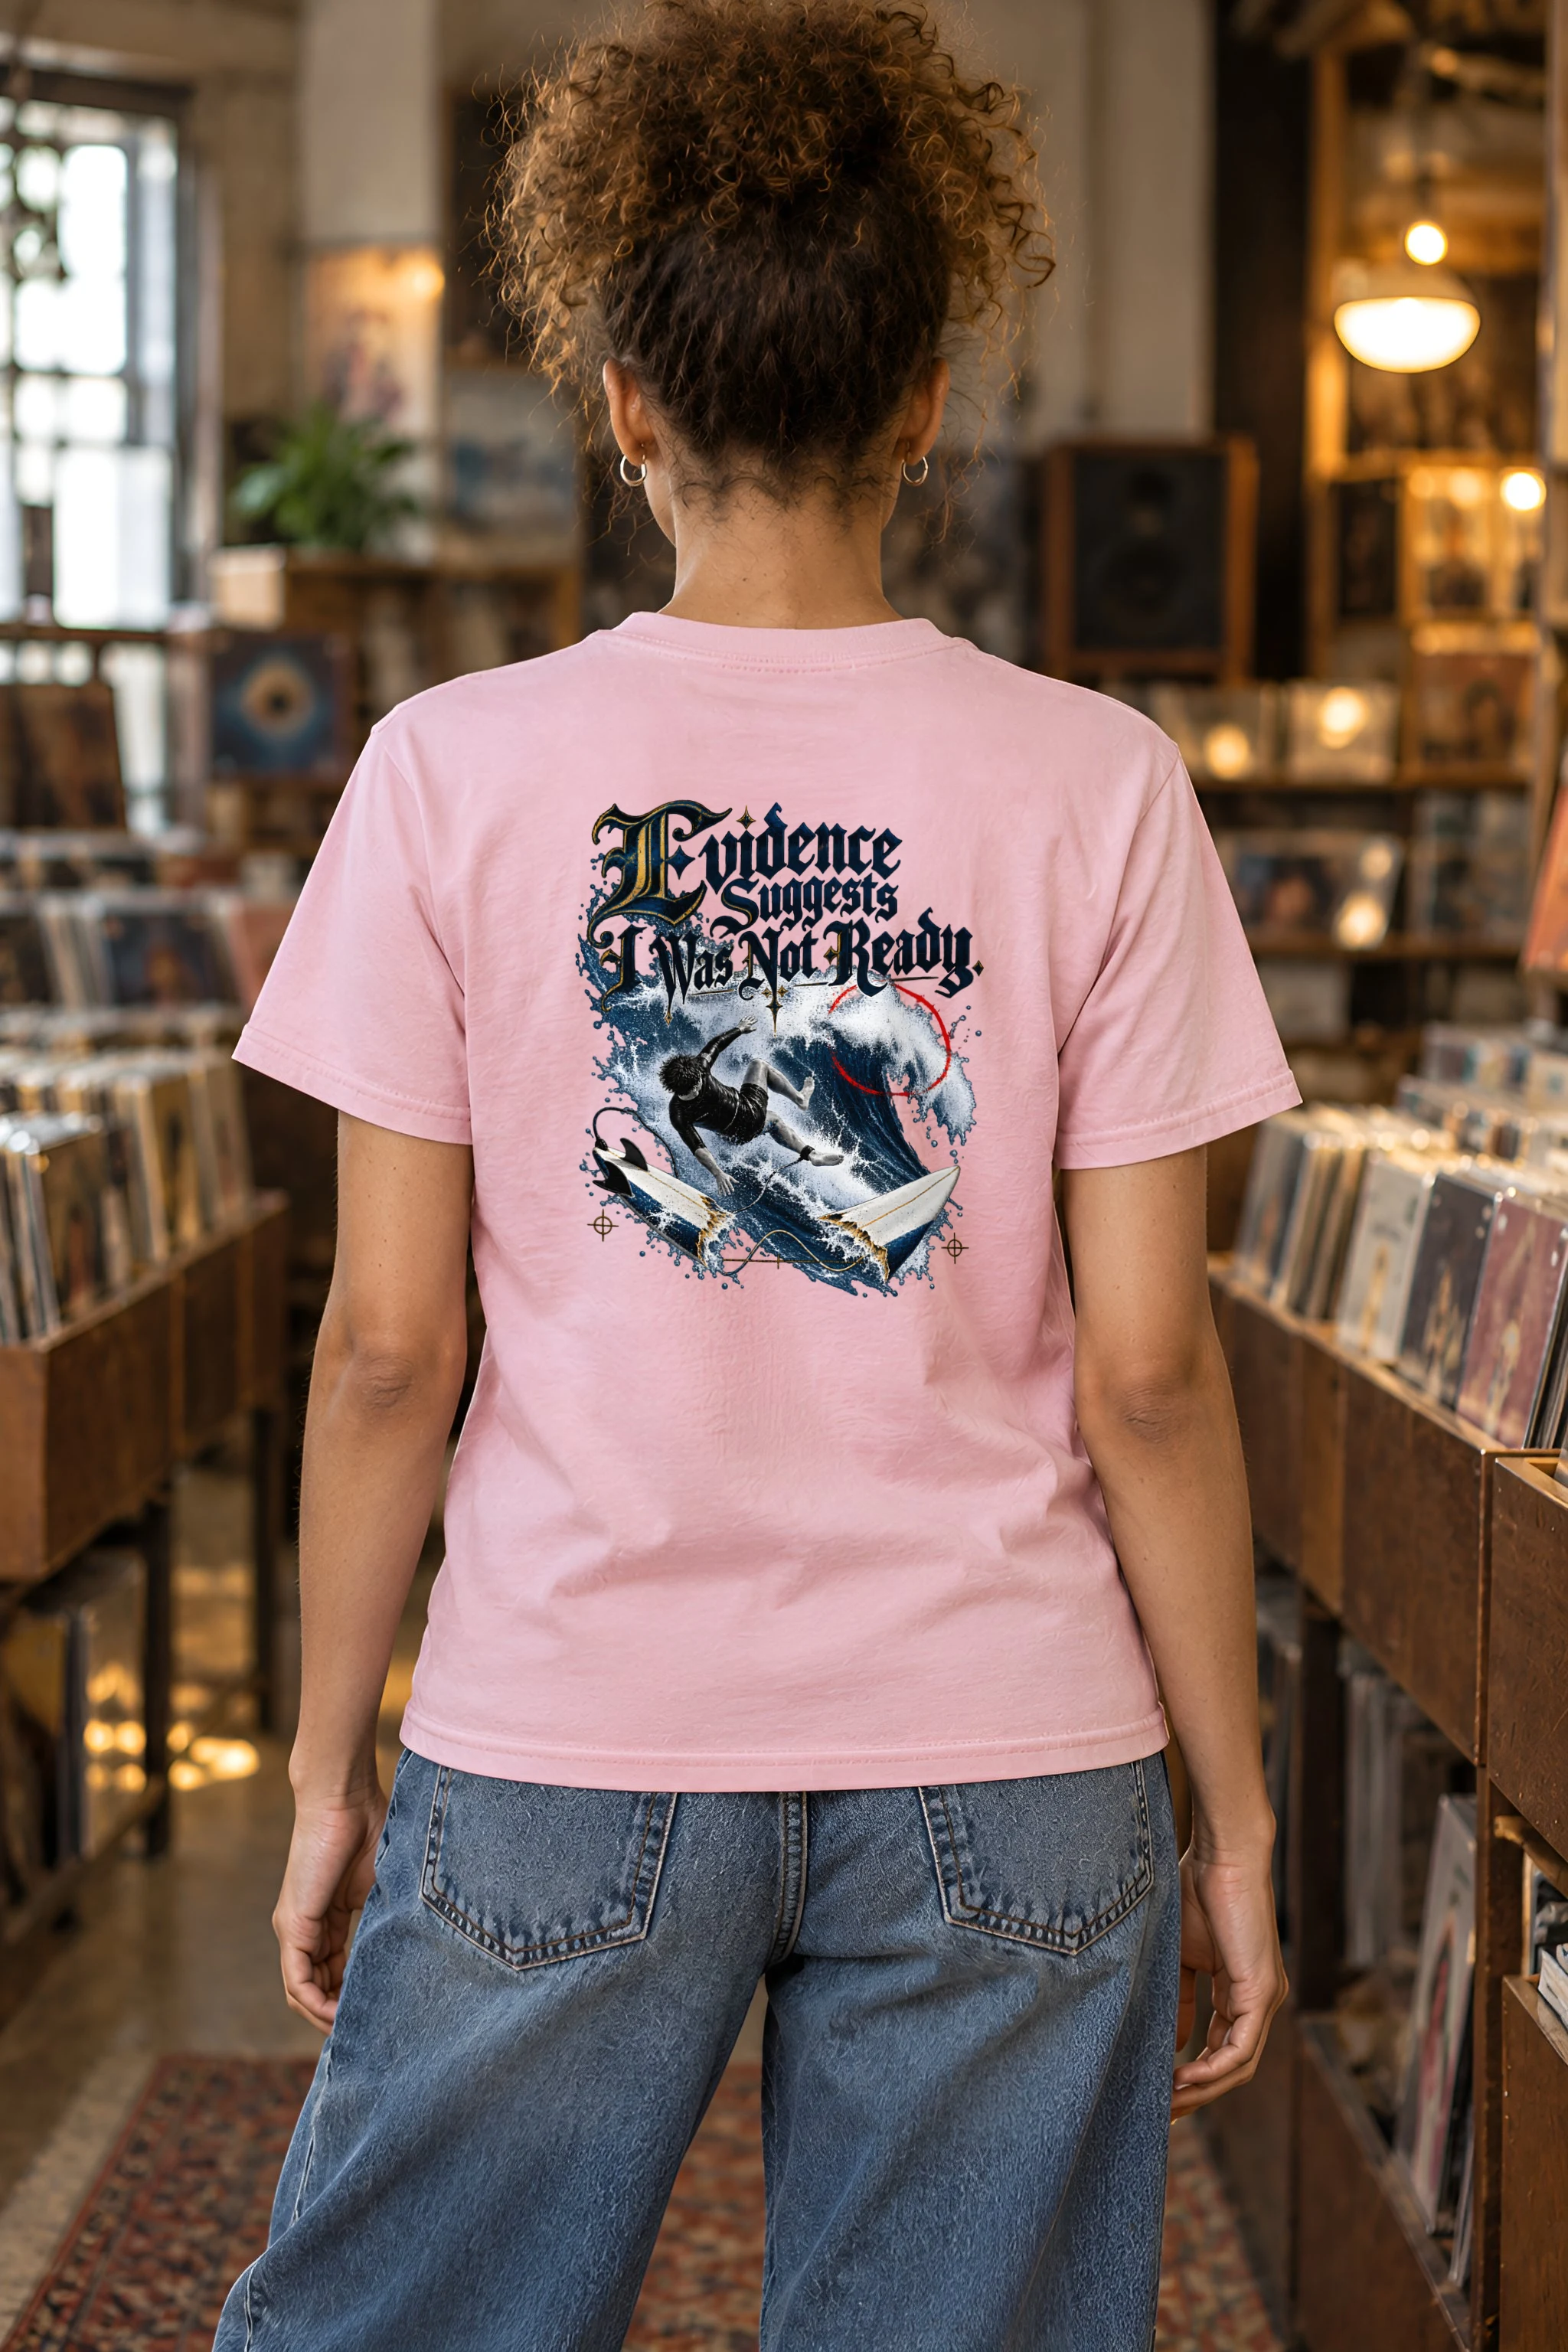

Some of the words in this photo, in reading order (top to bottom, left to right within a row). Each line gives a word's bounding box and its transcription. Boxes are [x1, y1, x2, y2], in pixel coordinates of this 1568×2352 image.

[590, 799, 903, 948] Evidence
[710, 872, 899, 938] Suggests
[600, 924, 647, 1012] I
[649, 930, 736, 1006] Was
[737, 925, 819, 1001] Not
